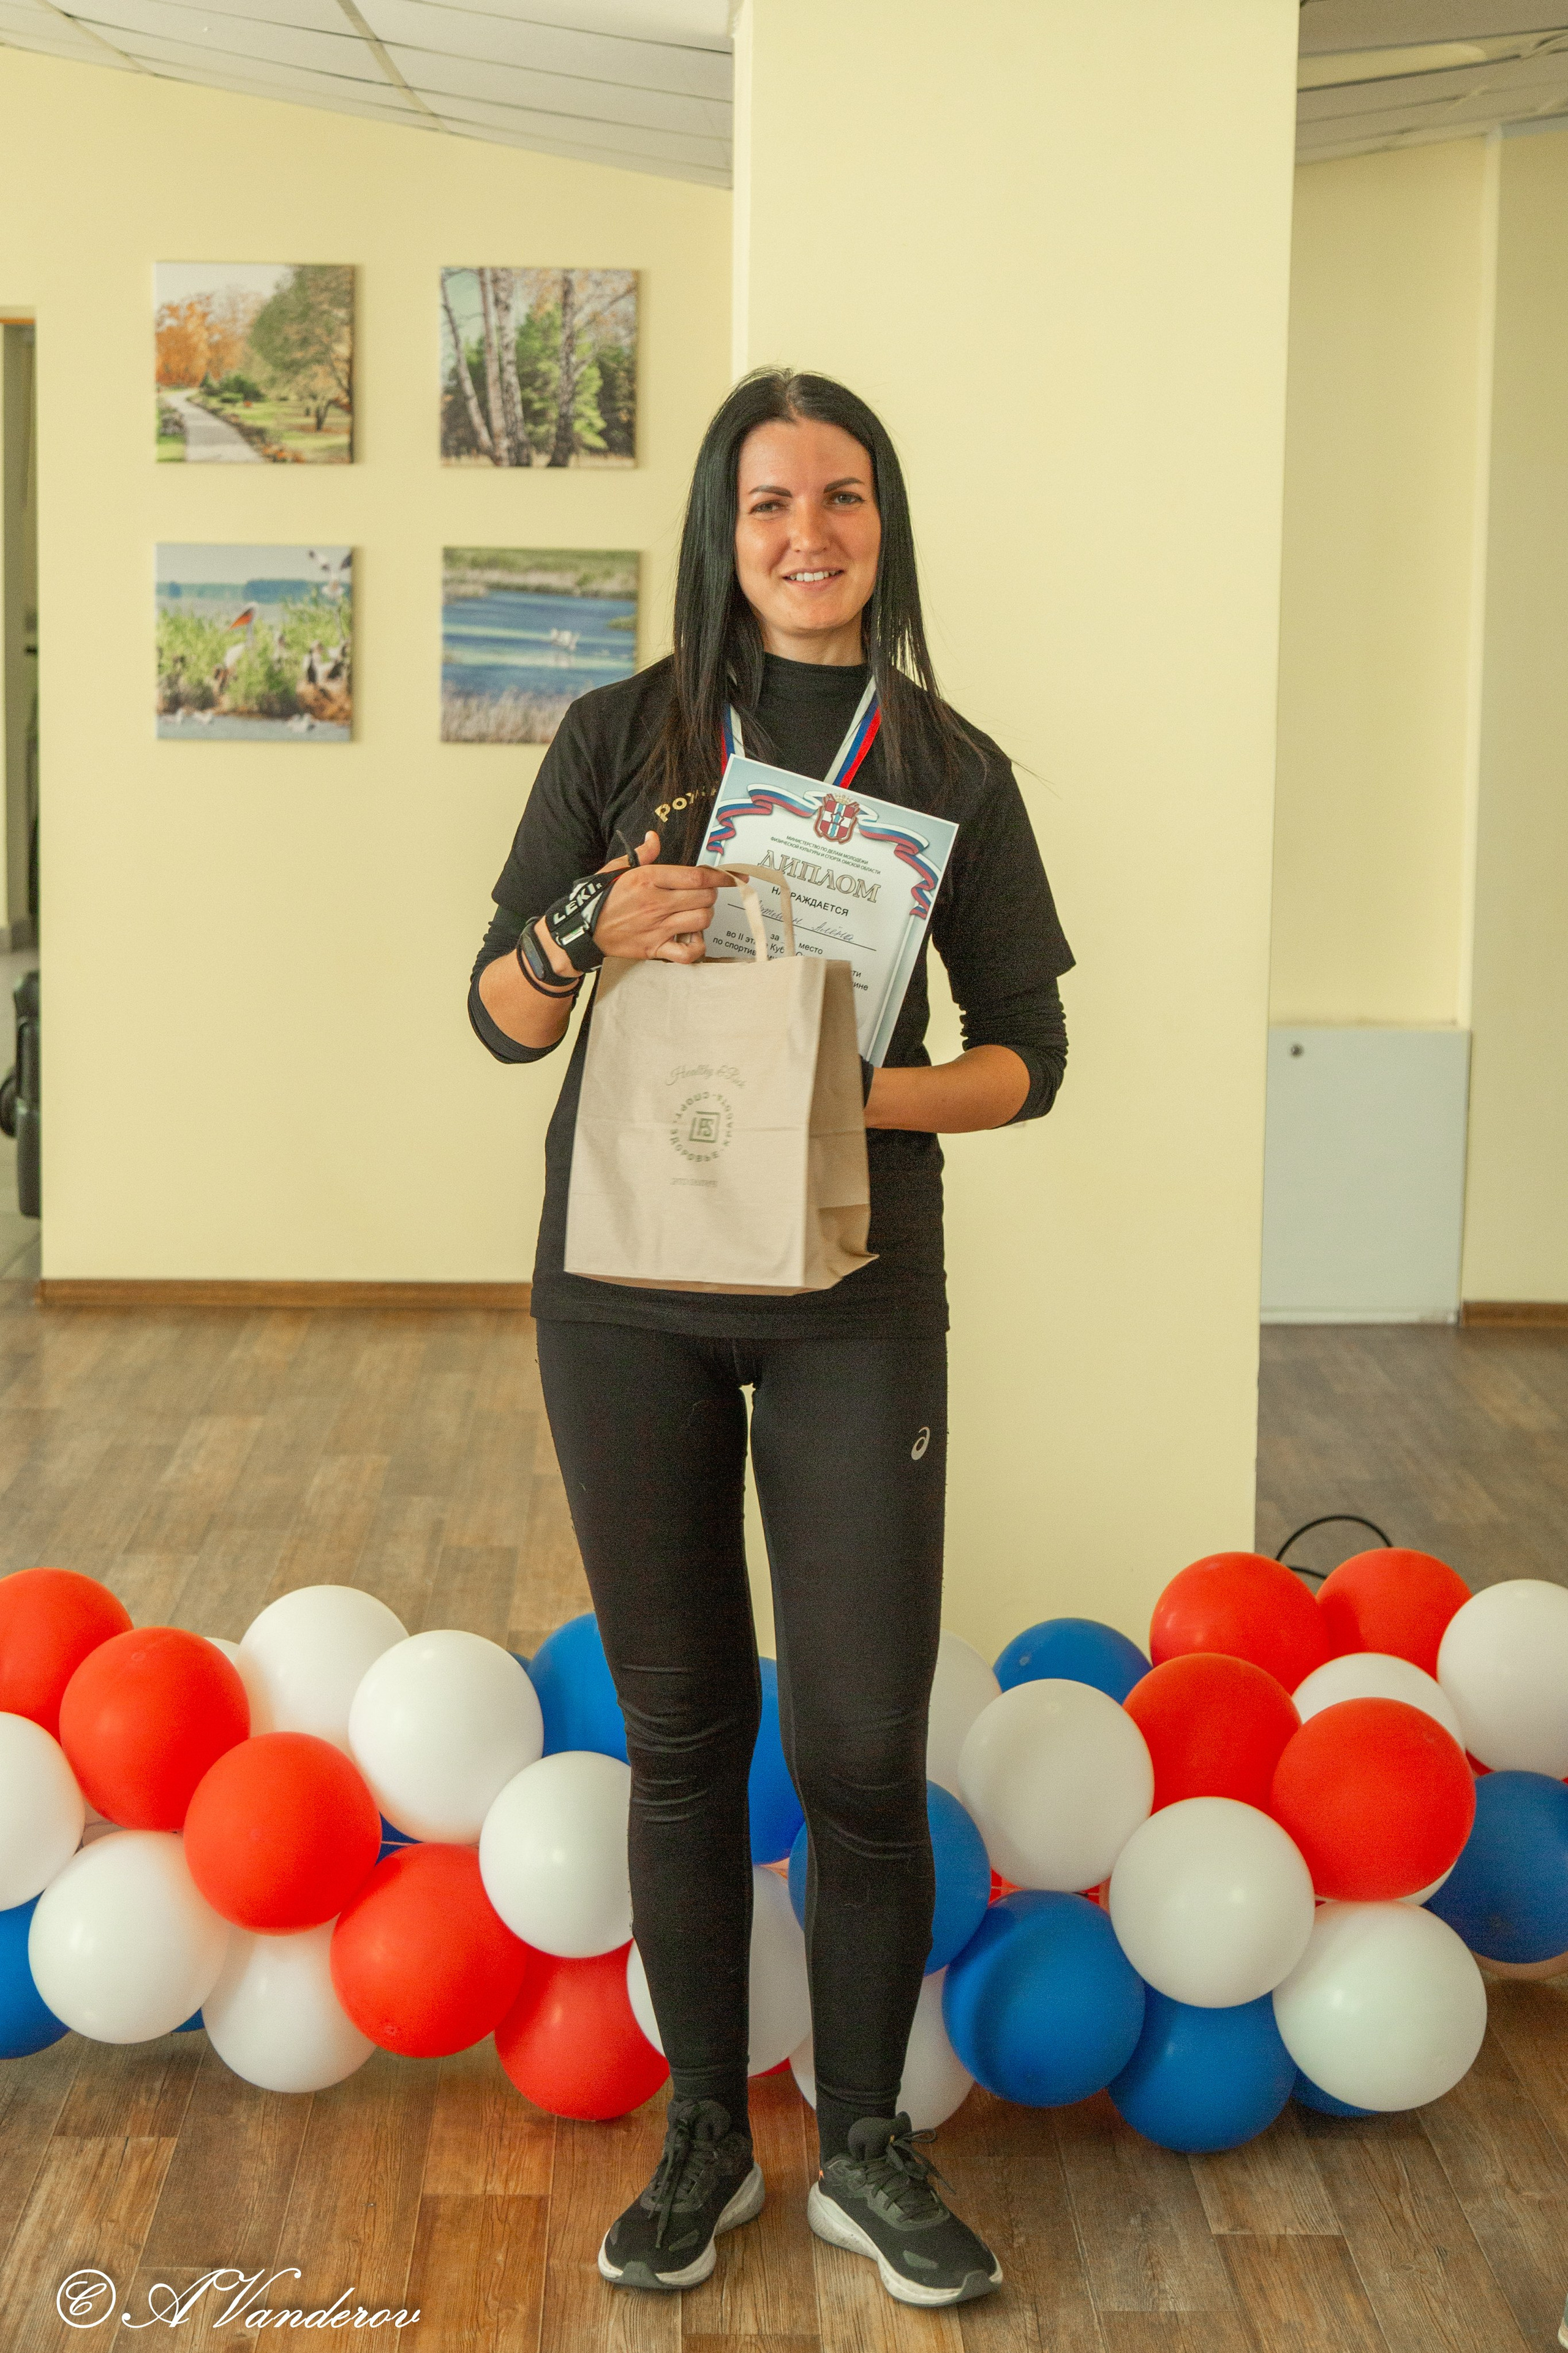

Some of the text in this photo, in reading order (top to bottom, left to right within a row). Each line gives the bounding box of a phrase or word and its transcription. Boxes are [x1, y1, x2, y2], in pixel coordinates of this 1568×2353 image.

[771, 836, 799, 849] ФИЗИЧЕСКОЙ
[799, 846, 821, 856] КУЛЬТУРЫ
[824, 853, 842, 863] СПОРТА
[841, 859, 861, 869] ОМСКОЙ
[860, 865, 881, 875] ОБЛАСТИ
[786, 836, 821, 850] МИНИСТЕРСТВО
[827, 848, 843, 857] ДЕЛАМ
[757, 849, 881, 903] ДИПЛОМ
[553, 883, 597, 925] LEKI
[771, 886, 849, 917] НРАЖДАЕТСЯ
[798, 942, 824, 955] место
